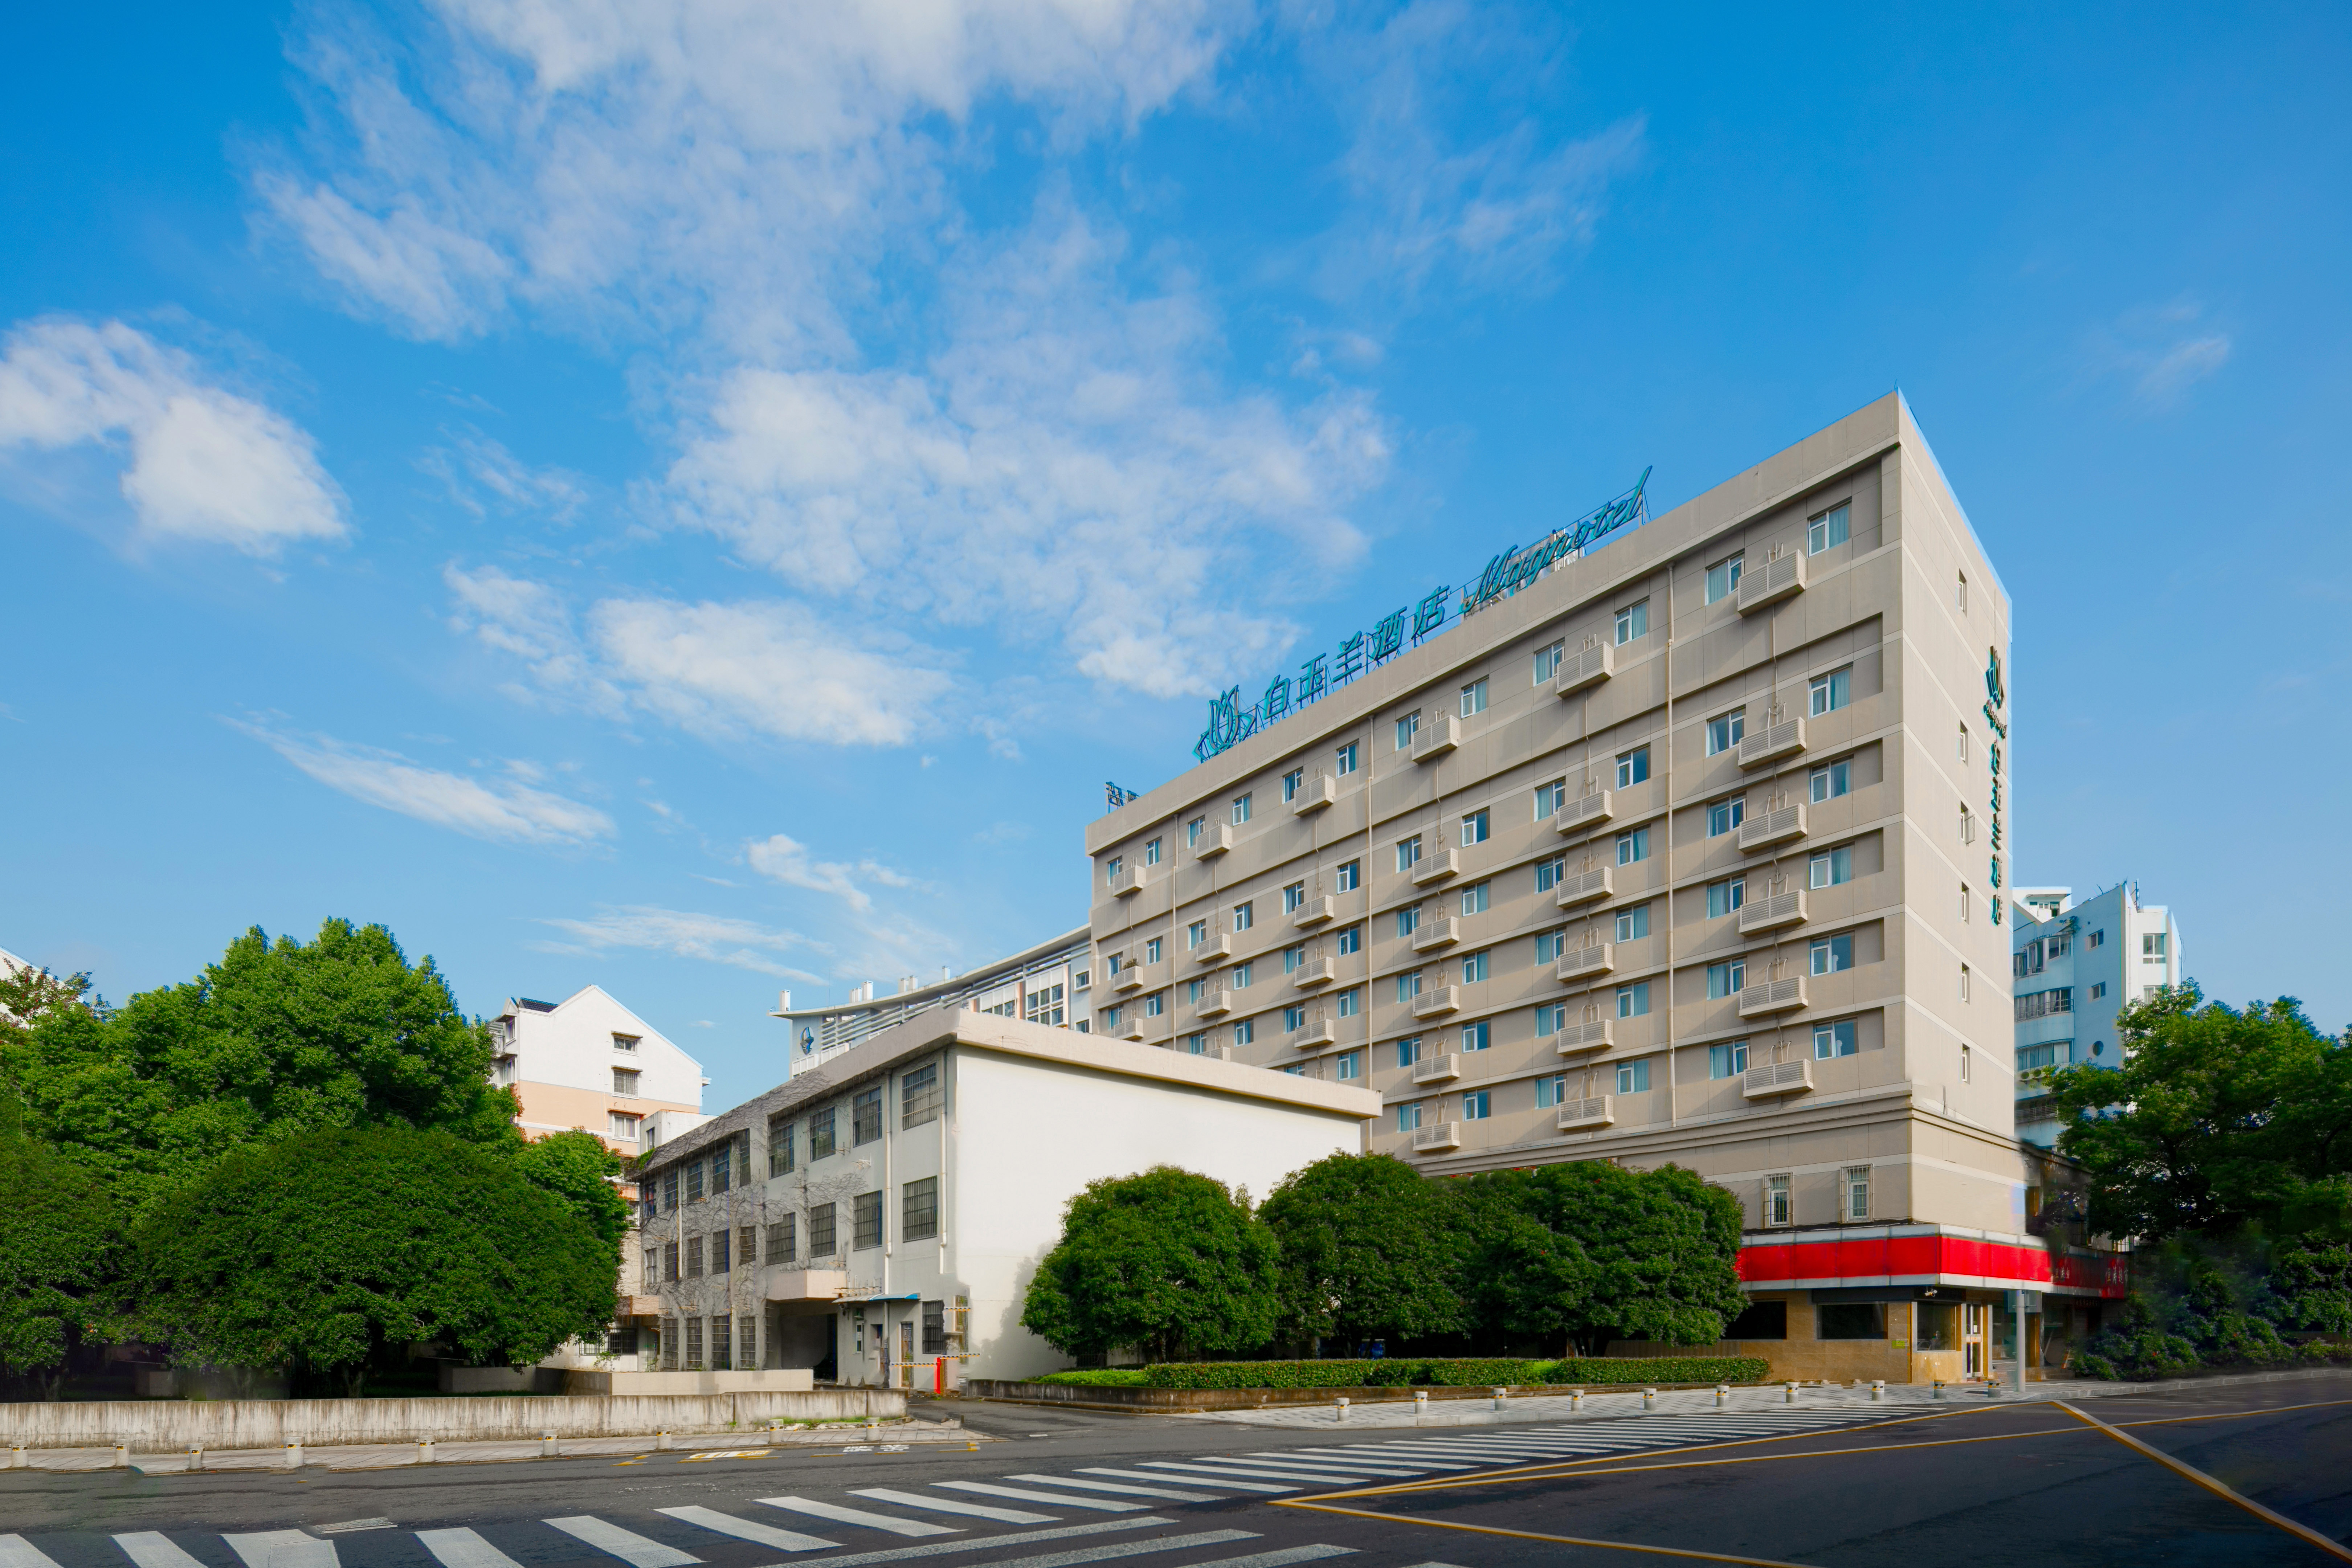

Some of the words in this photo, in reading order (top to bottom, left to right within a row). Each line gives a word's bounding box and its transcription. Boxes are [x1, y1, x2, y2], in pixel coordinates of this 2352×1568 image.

[1263, 585, 1449, 720] 白玉兰酒店
[1459, 465, 1653, 613] Magnotel
